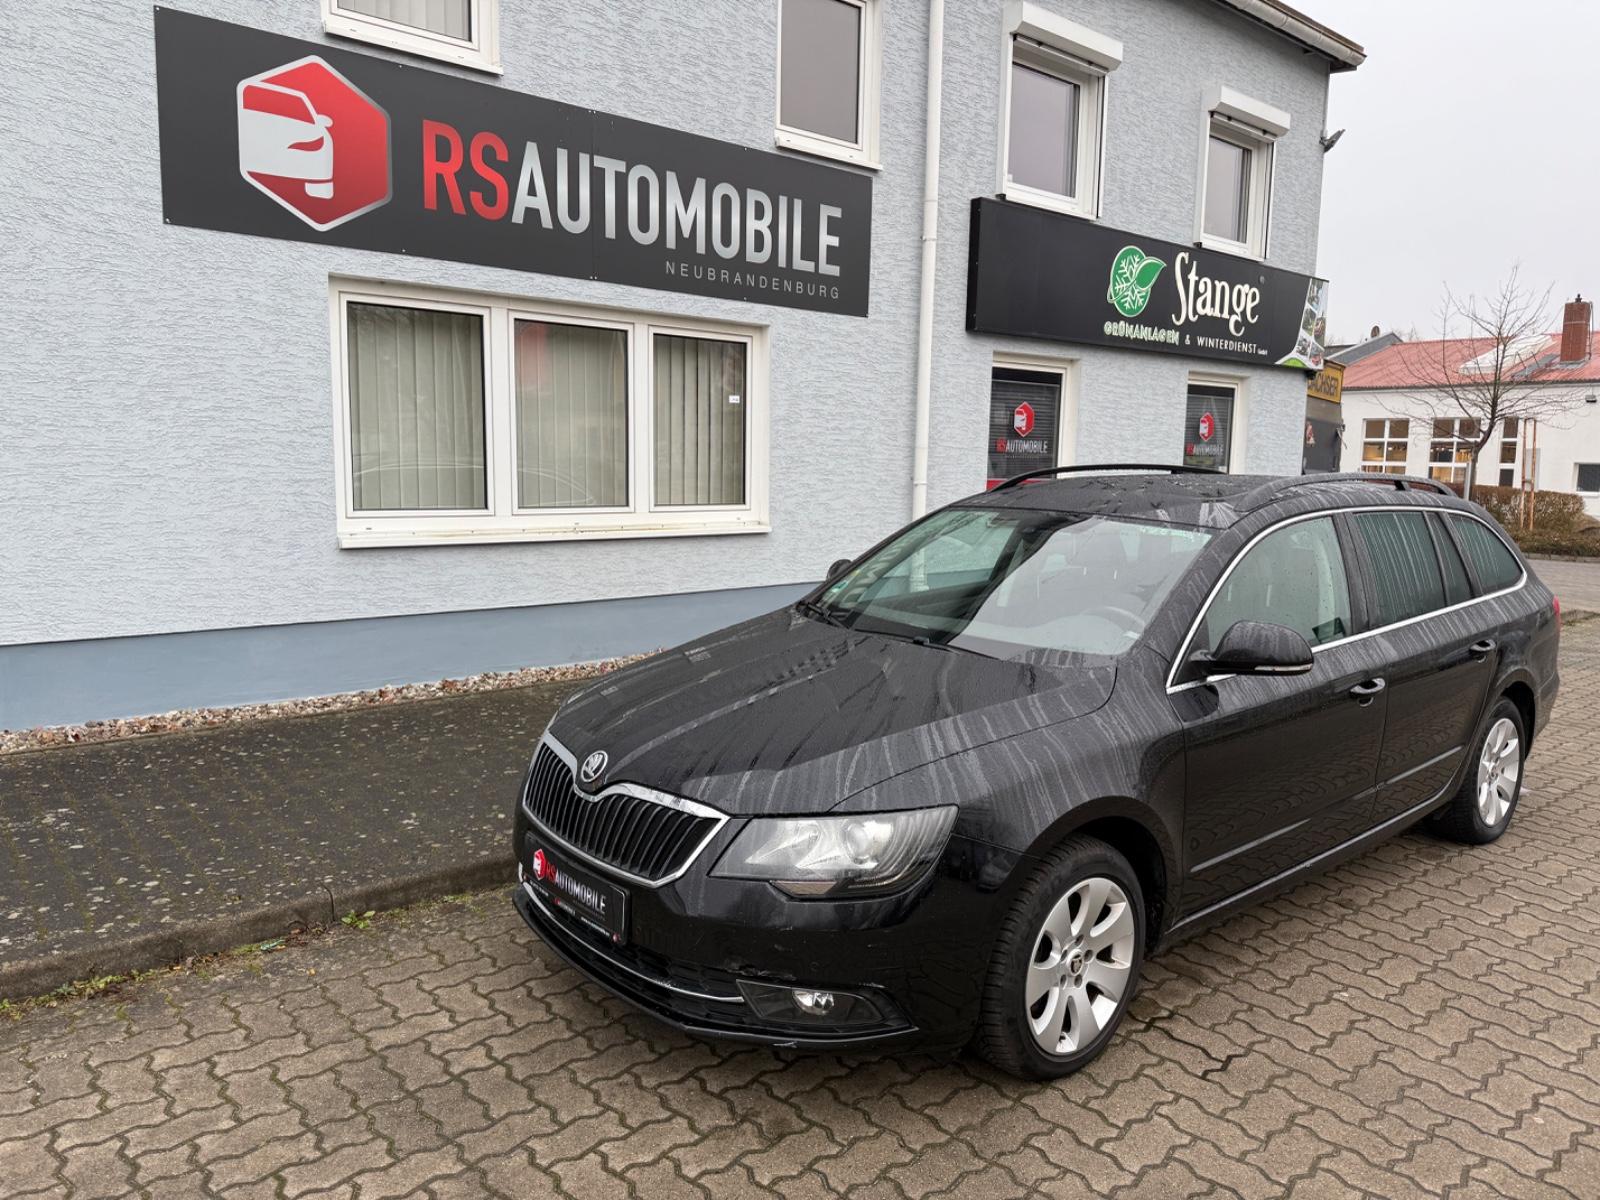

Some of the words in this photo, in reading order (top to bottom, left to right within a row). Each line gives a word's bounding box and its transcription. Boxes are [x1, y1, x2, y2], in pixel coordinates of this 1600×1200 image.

[665, 260, 840, 300] NEUBRANDENBURG
[1171, 251, 1260, 337] Stange
[1104, 320, 1180, 346] GRÜNANLAGEN
[1185, 334, 1191, 345] &
[1197, 335, 1257, 354] WINTERDIENST
